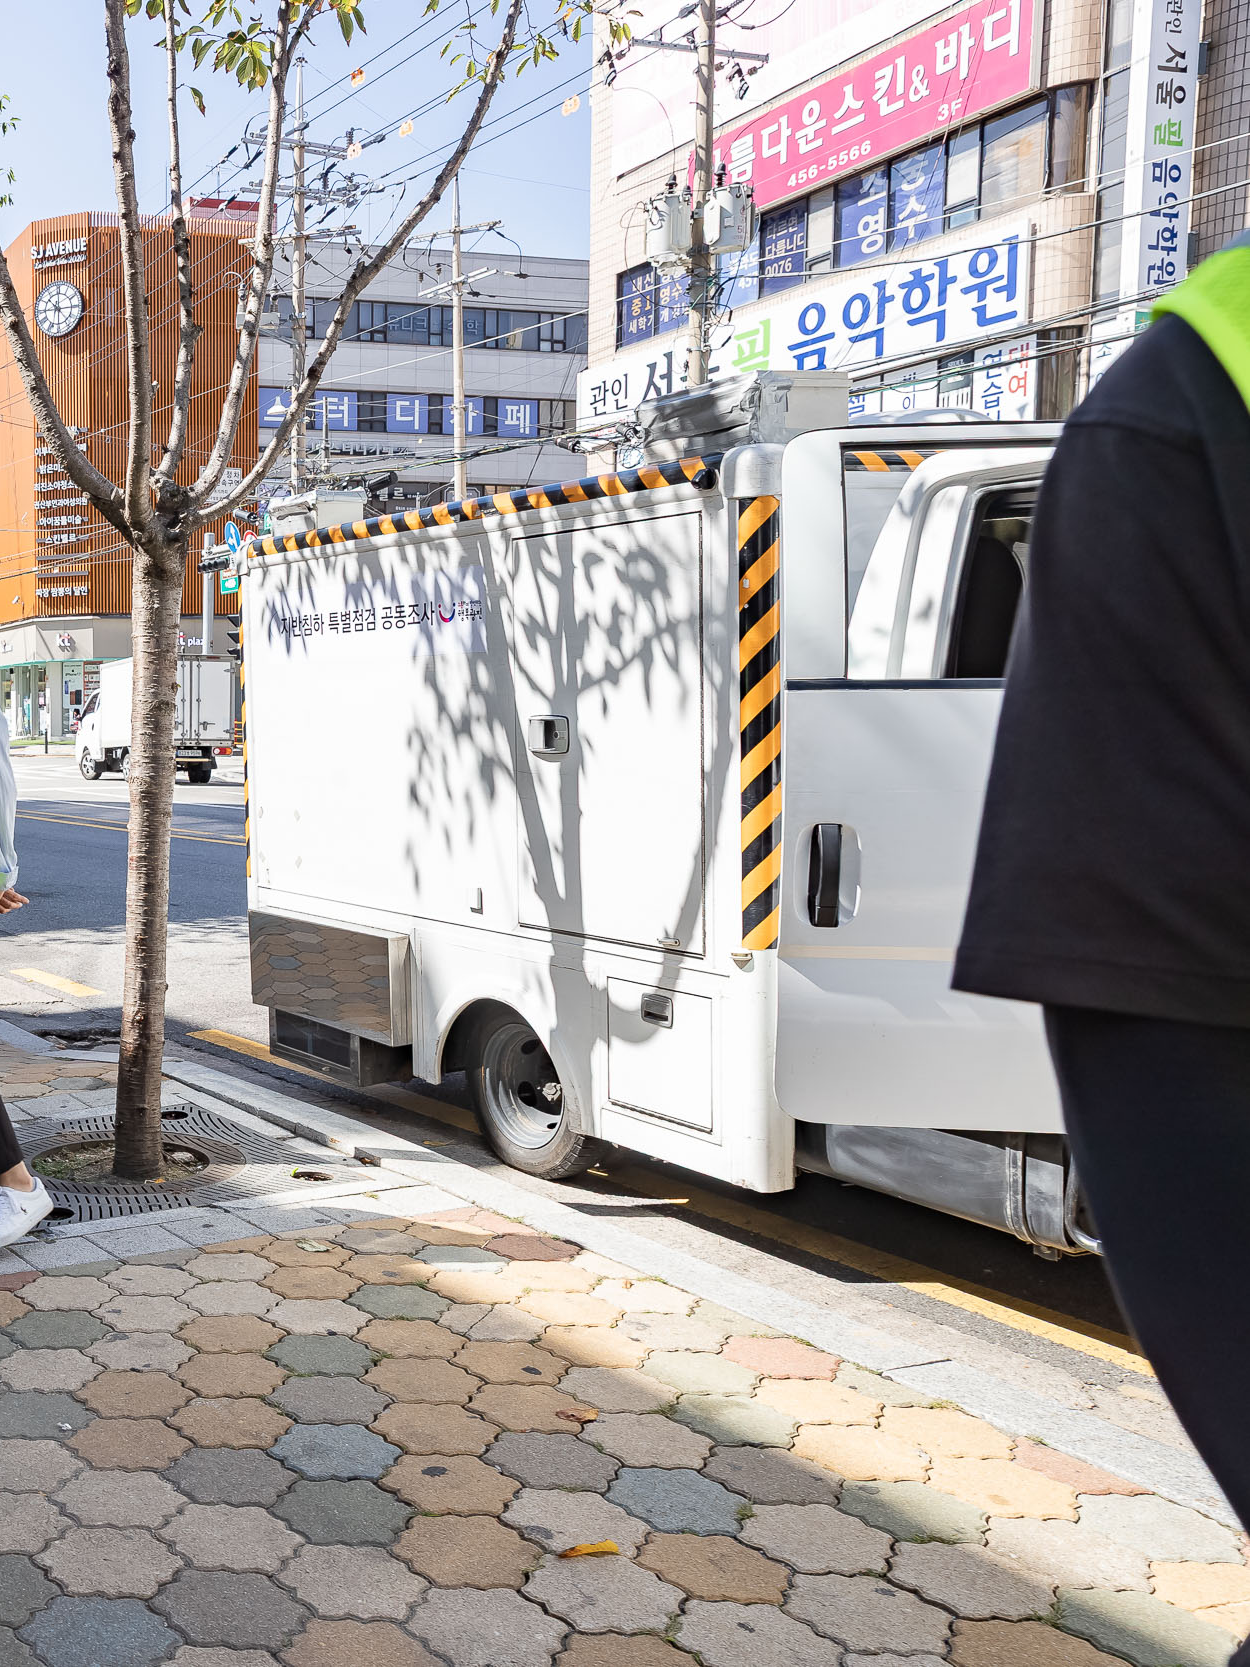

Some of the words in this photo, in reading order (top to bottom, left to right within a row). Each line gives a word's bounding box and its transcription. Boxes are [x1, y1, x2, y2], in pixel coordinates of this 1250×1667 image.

[937, 98, 963, 121] 3F
[787, 140, 872, 188] 456-5566
[44, 237, 87, 258] AVENUE
[589, 373, 628, 417] 관인
[981, 349, 1004, 421] 연습
[280, 611, 325, 638] 지반침하
[327, 606, 377, 632] 특별점검
[380, 601, 436, 631] 공동조사
[56, 632, 71, 647] kt
